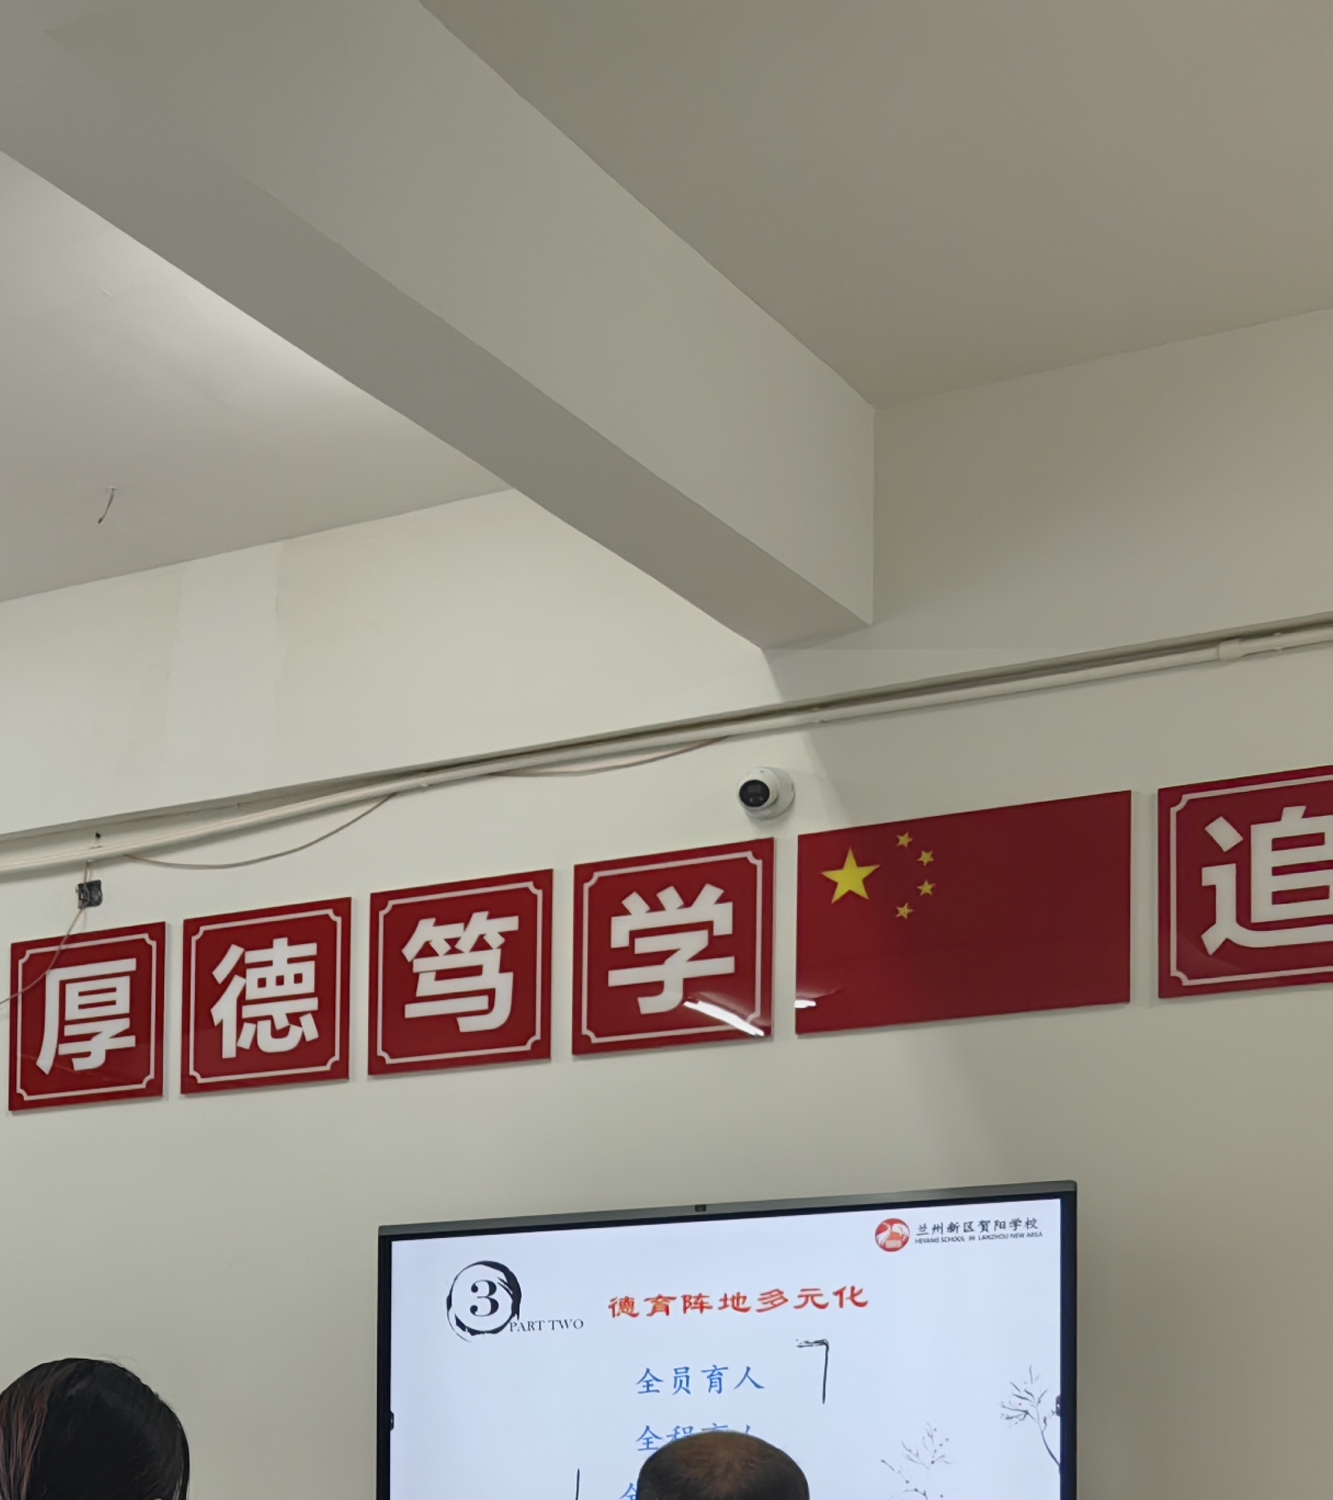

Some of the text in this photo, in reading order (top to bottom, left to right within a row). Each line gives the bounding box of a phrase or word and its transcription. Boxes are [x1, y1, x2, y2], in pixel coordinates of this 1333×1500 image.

[1200, 804, 1333, 957] 追
[35, 883, 735, 1076] 厚德笃学
[916, 1217, 1039, 1237] 兰州新区贺阳学校
[940, 1235, 965, 1243] SCHOOL
[470, 1279, 500, 1318] 3
[607, 1285, 869, 1319] 德育阵地多元化
[509, 1318, 584, 1333] PART TWO
[635, 1364, 765, 1396] 全员育人
